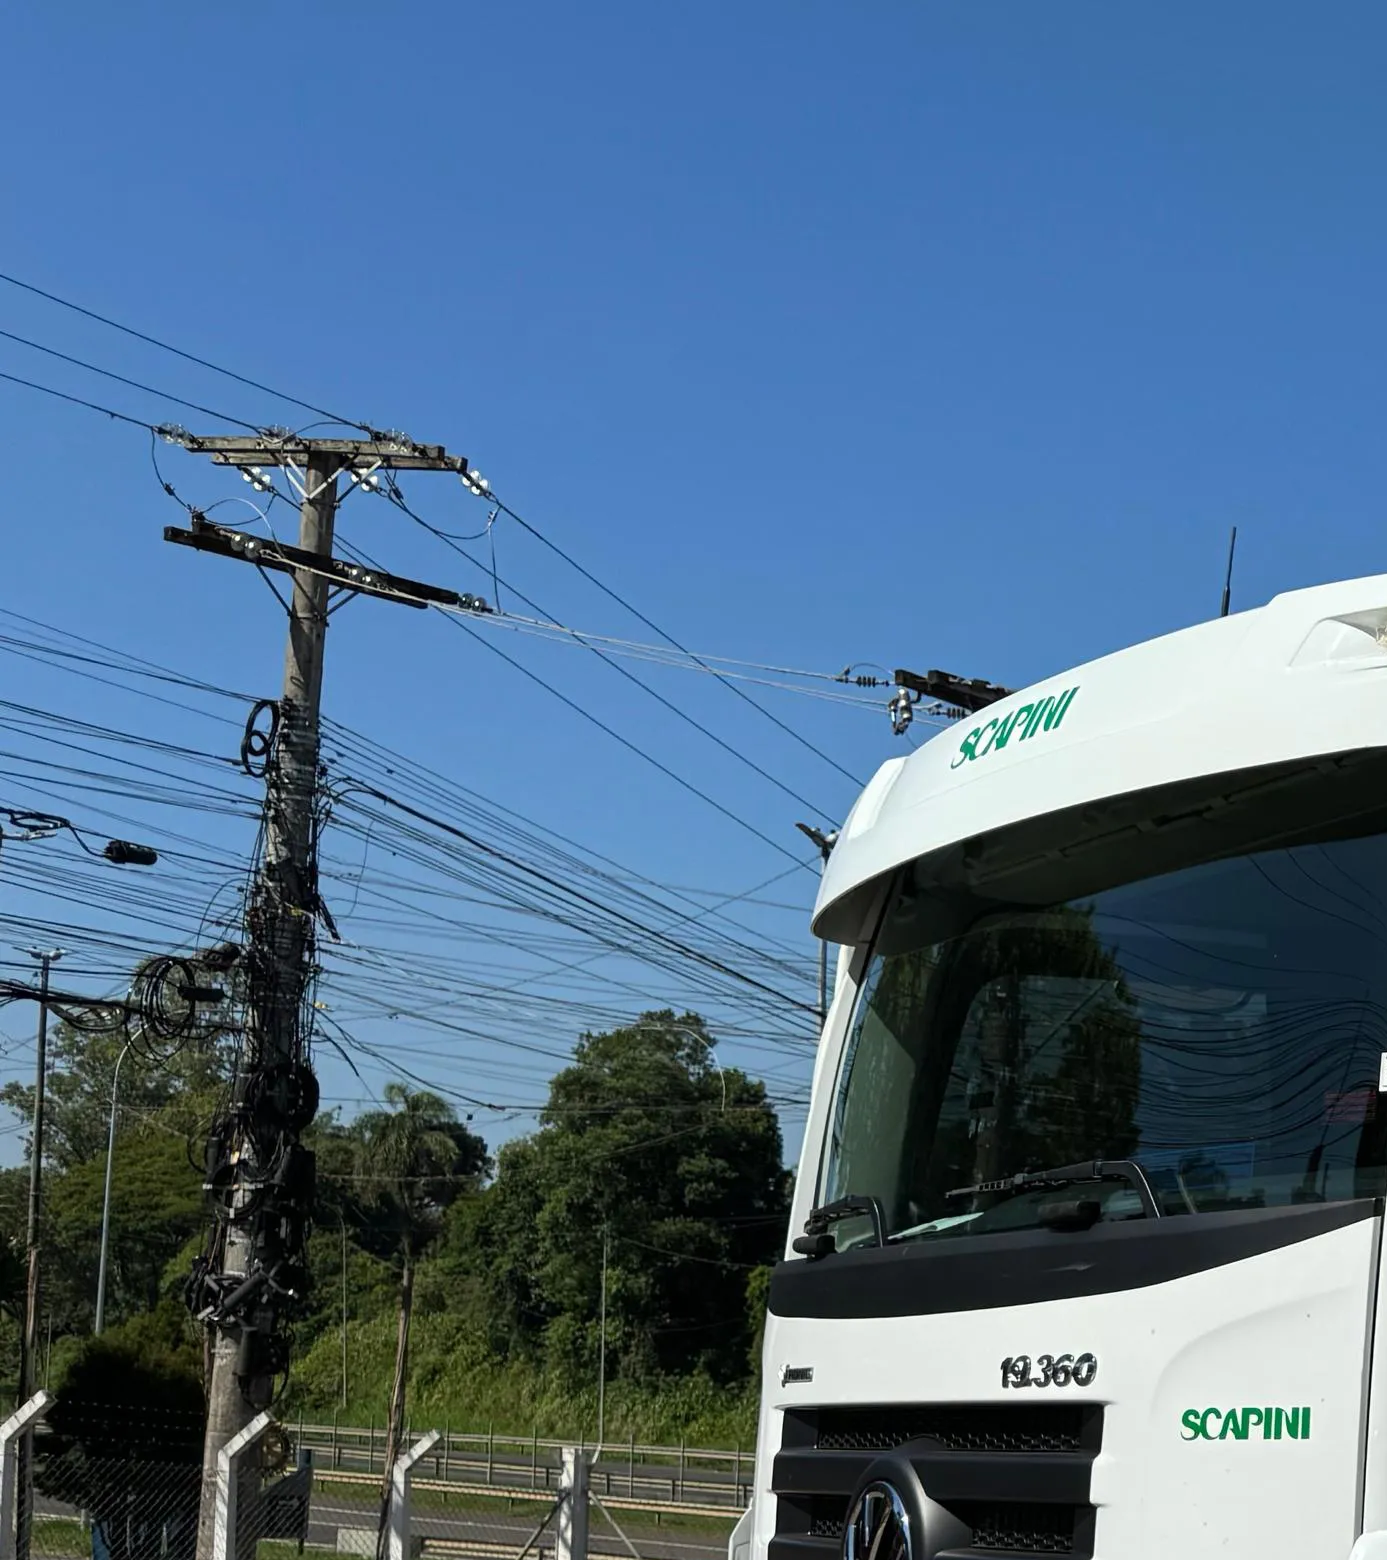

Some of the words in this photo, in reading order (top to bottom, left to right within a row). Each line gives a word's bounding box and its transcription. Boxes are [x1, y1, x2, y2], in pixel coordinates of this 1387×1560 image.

[950, 686, 1080, 770] SCAPINI
[1001, 1353, 1098, 1389] 19.360
[1180, 1406, 1311, 1441] SCAPINI
